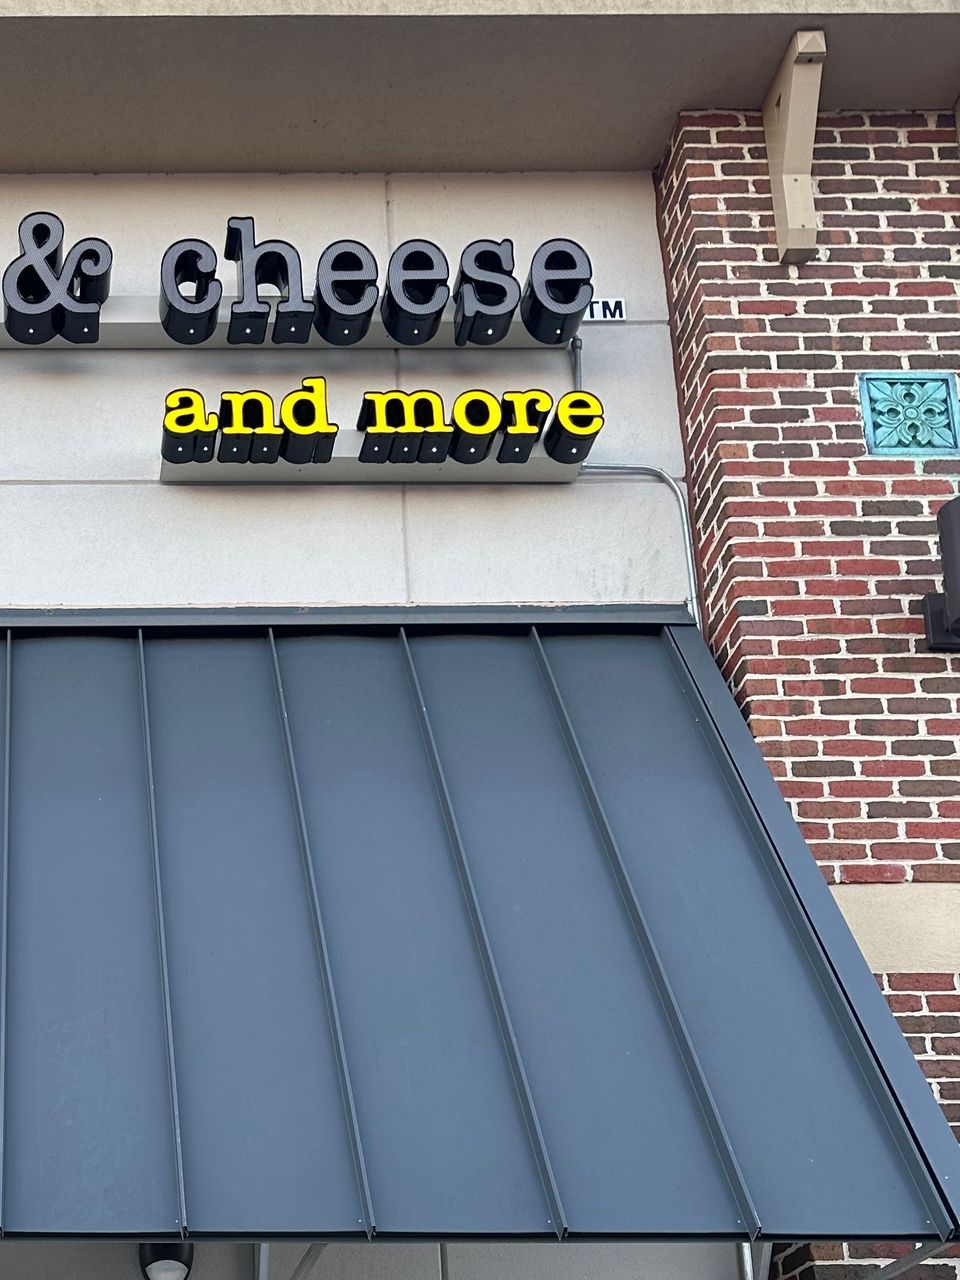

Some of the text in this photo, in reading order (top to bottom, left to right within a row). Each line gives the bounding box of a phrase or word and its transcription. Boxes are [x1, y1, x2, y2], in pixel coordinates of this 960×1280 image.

[3, 211, 114, 338] &
[159, 216, 595, 338] cheese
[162, 377, 606, 452] and more
